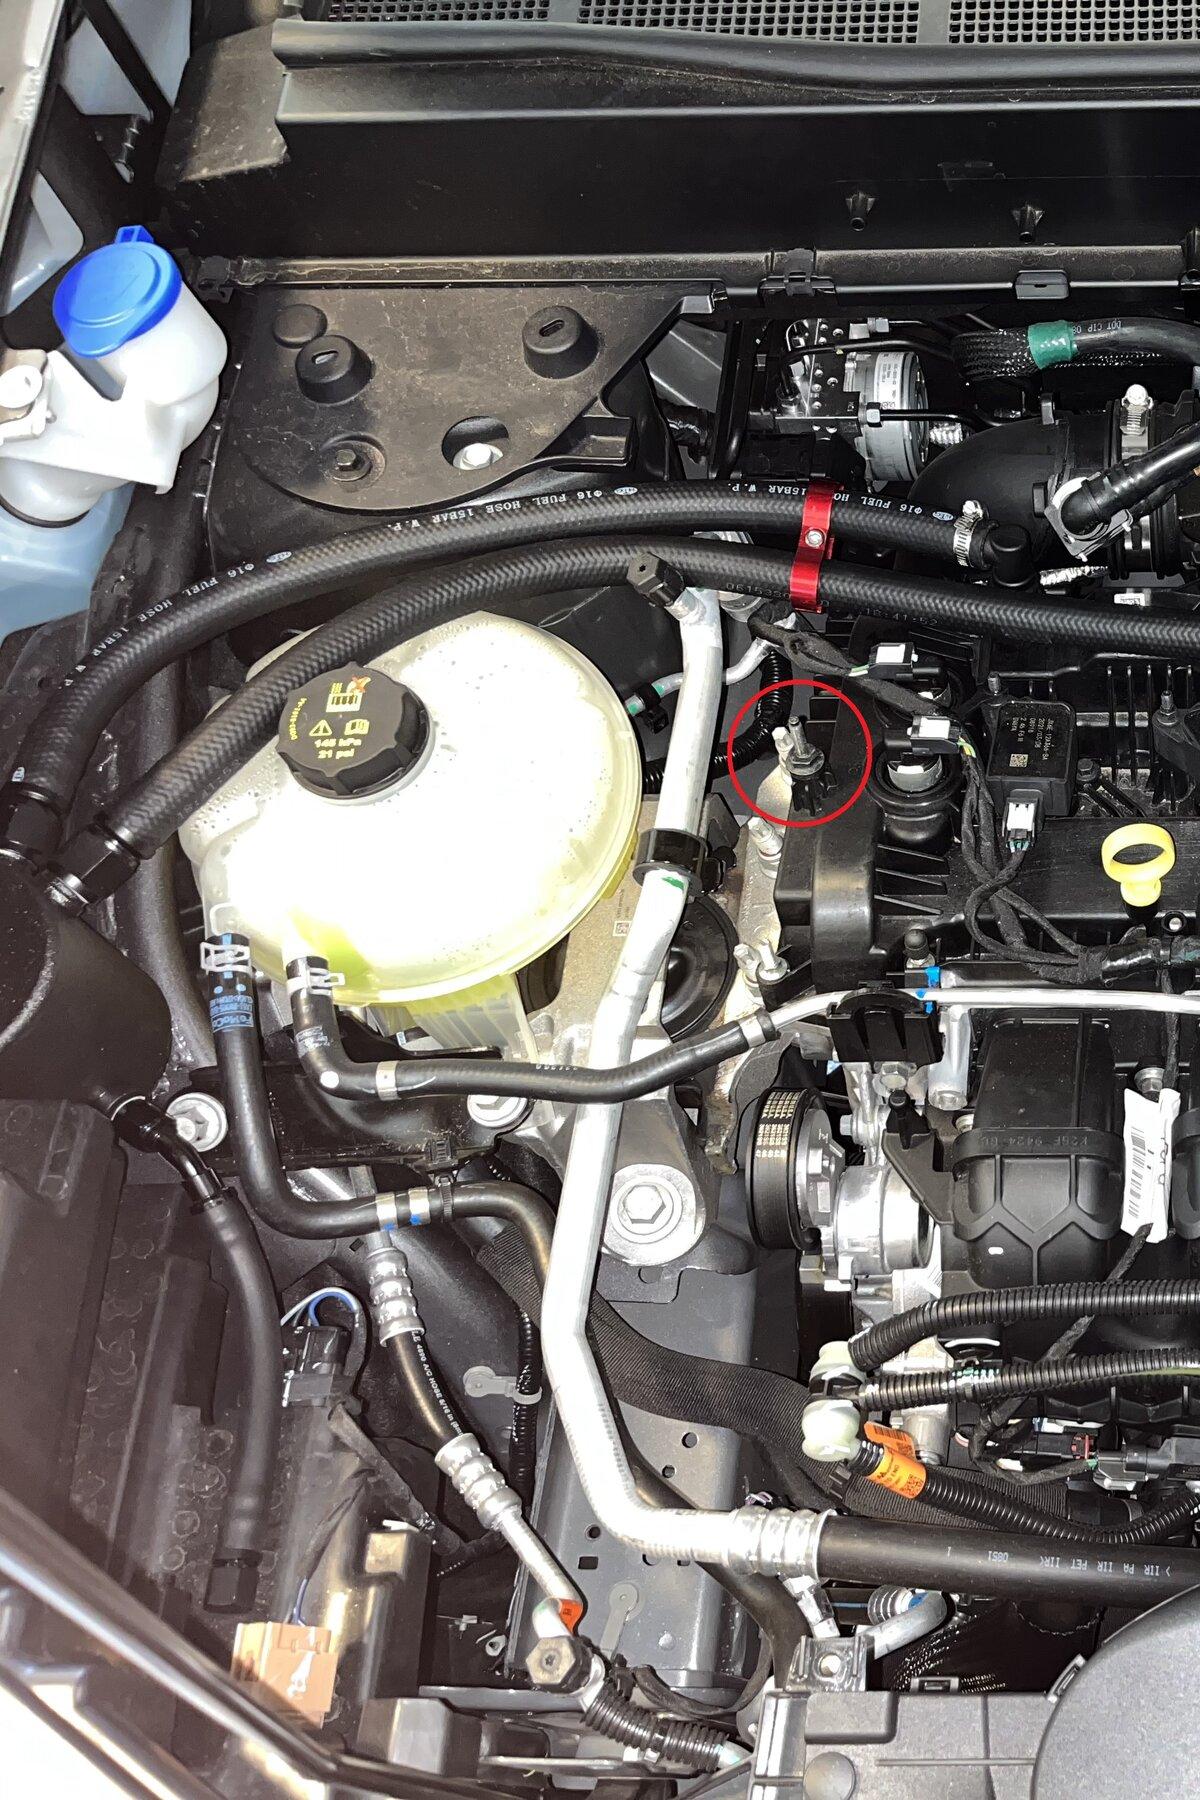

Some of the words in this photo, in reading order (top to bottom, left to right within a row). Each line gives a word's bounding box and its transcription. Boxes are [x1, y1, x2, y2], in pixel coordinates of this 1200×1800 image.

[768, 484, 807, 496] 15BAR
[532, 493, 567, 506] FUEL
[861, 496, 892, 509] FUEL
[486, 500, 521, 514] HOSE
[432, 508, 474, 524] 15BAR
[182, 577, 219, 597] FUEL
[137, 599, 173, 623] HOSE
[92, 626, 130, 657] 15BAR
[317, 749, 333, 759] 21
[423, 1363, 433, 1377] A/C
[429, 1378, 443, 1399] HOSE
[1070, 1558, 1087, 1571] PET
[1123, 1562, 1135, 1575] PA
